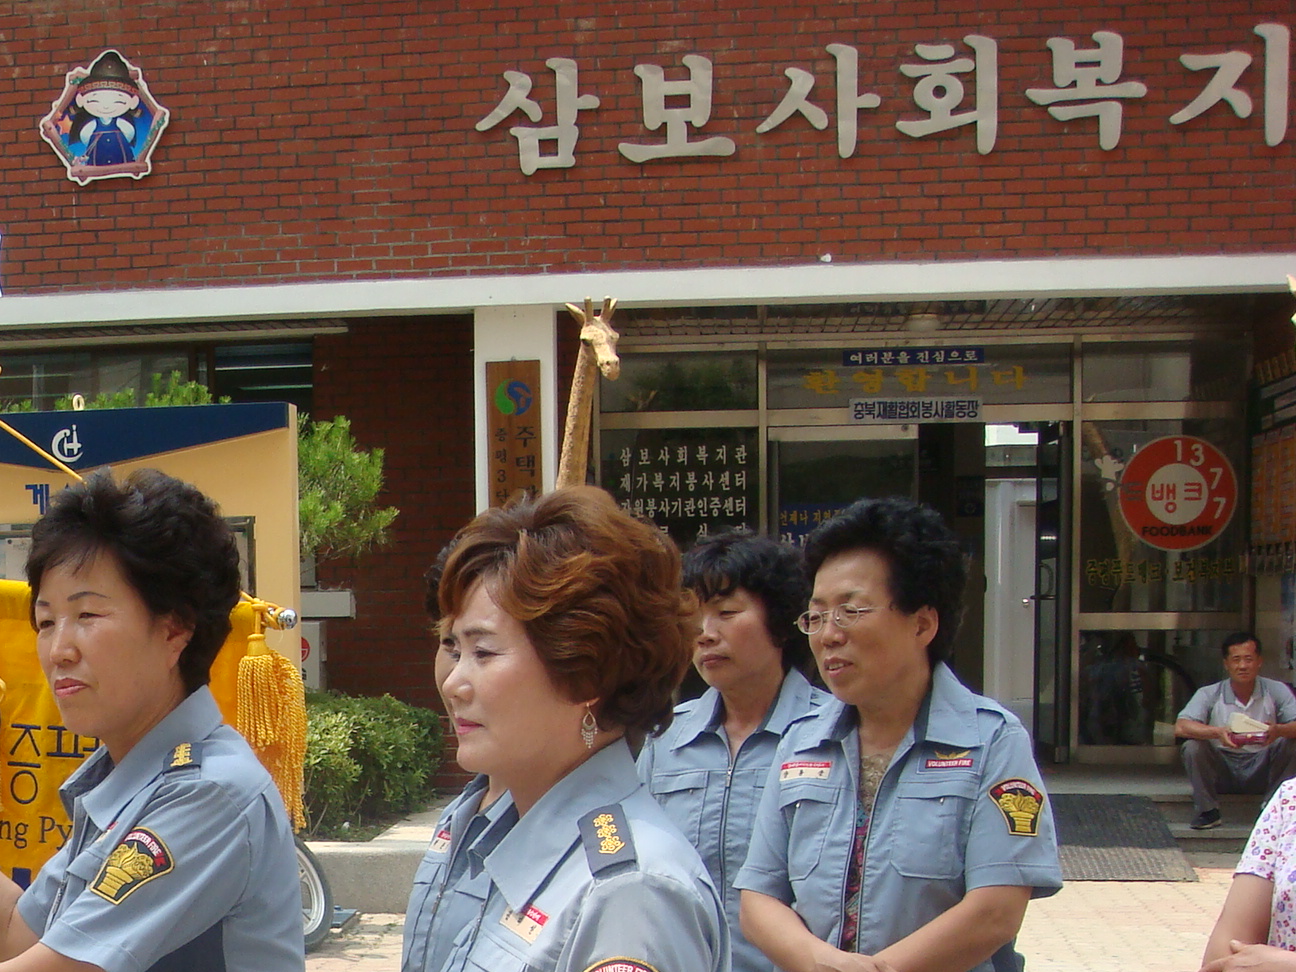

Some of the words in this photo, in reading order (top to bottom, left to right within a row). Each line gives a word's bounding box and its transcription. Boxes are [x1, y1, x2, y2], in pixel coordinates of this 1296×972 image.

[850, 350, 910, 364] 여러분을
[916, 349, 979, 363] 진심으로
[620, 445, 747, 466] 삼보사회복지관
[620, 470, 746, 492] 재가복지봉사센터
[1142, 525, 1214, 537] FOODBANK
